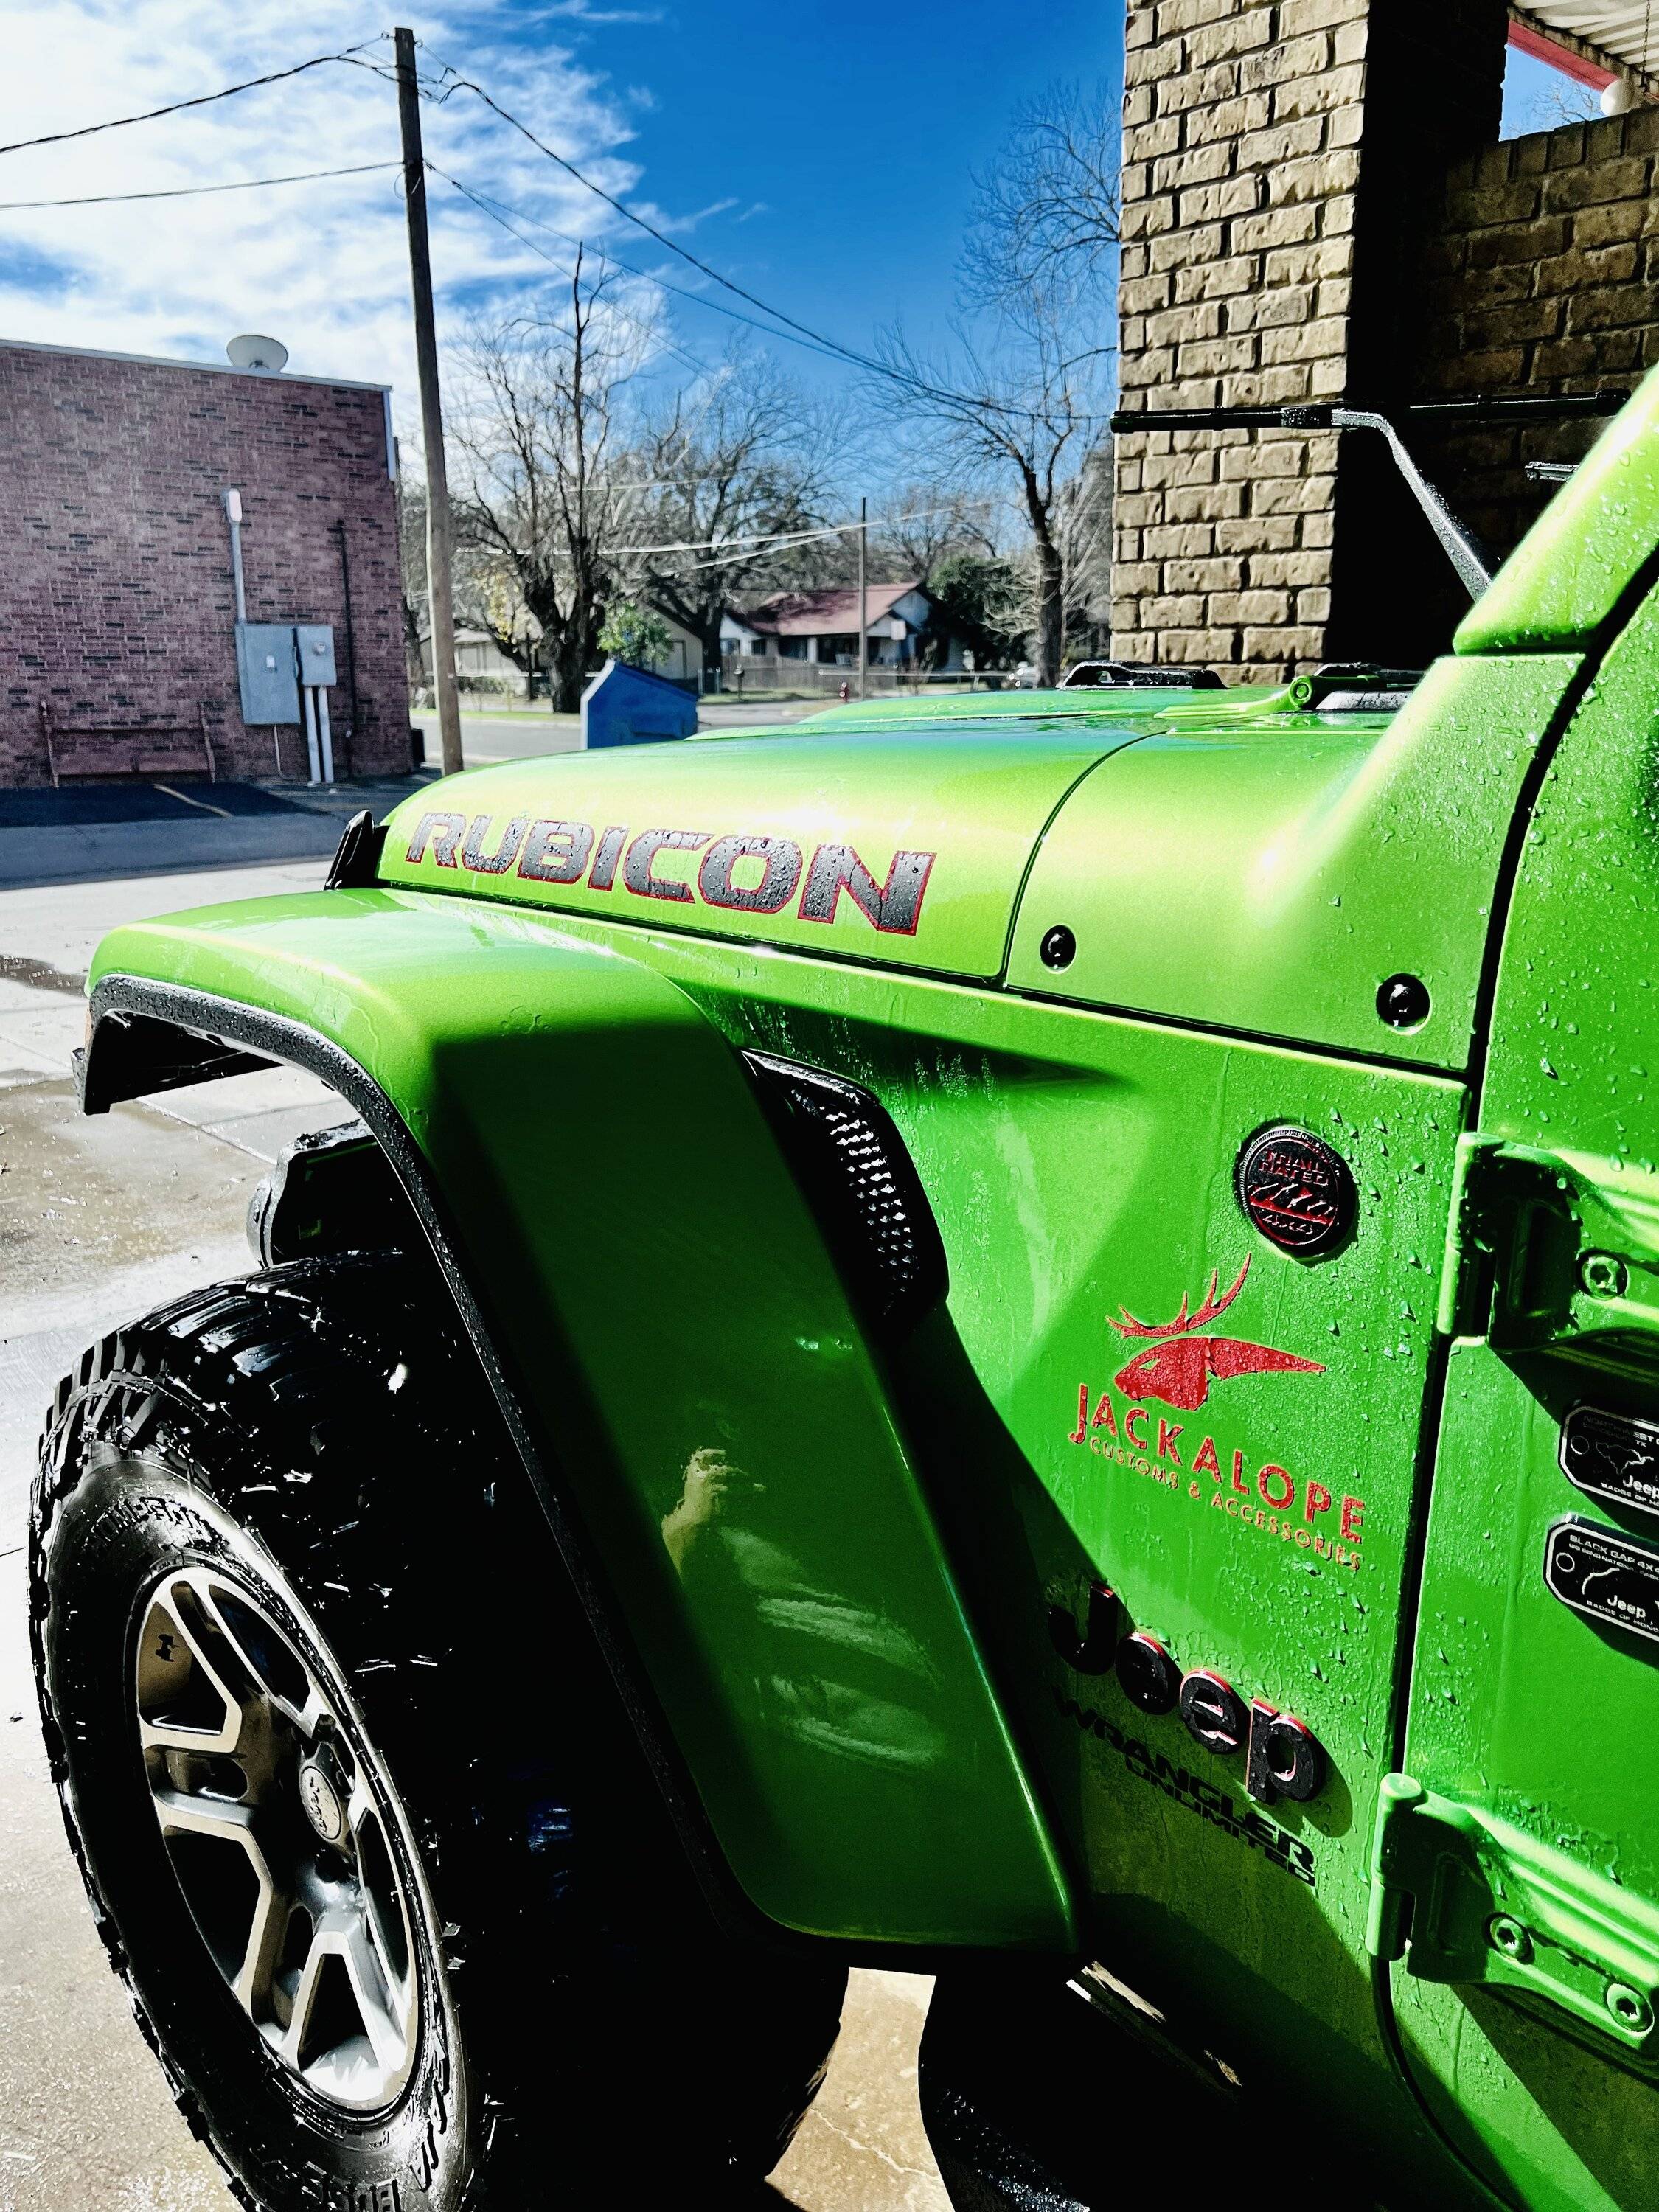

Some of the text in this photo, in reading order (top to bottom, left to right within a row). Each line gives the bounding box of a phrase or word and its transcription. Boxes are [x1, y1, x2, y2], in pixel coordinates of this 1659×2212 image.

[405, 812, 937, 936] RUBICON
[1068, 1383, 1366, 1545] JACKALOPE
[1090, 1437, 1361, 1571] CUSTOMS & ACCESSORIES
[1569, 1534, 1608, 1555] BLACK
[1610, 1549, 1635, 1564] GAP
[1581, 1548, 1601, 1560] BEND
[1601, 1555, 1641, 1575] NATIONA
[1586, 1599, 1616, 1616] BADGE
[1618, 1613, 1630, 1621] OF
[1607, 1594, 1646, 1619] Jeep
[1048, 1580, 1318, 1805] Jeep
[1050, 1684, 1314, 1873] WRANGLER
[1124, 1754, 1316, 1887] UNLIMITED
